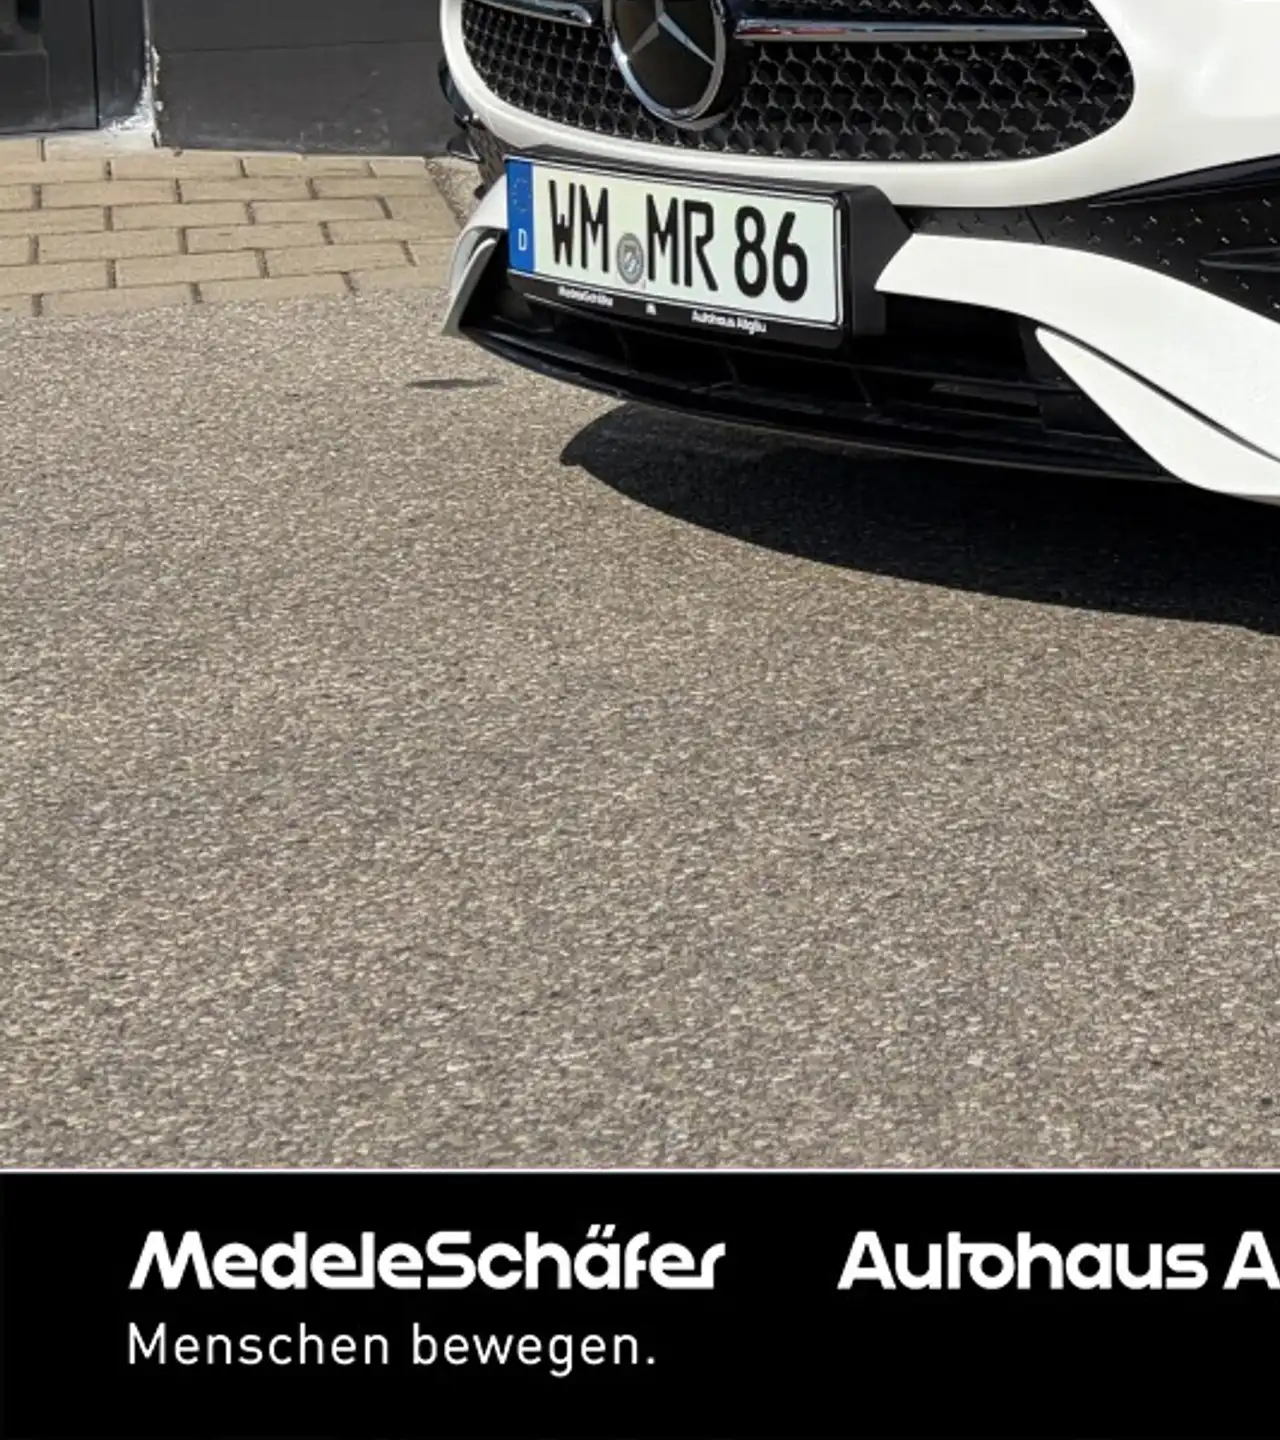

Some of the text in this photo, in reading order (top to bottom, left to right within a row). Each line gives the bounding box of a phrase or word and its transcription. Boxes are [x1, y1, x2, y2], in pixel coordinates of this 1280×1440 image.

[517, 227, 528, 251] D
[548, 179, 809, 303] WM MR 86
